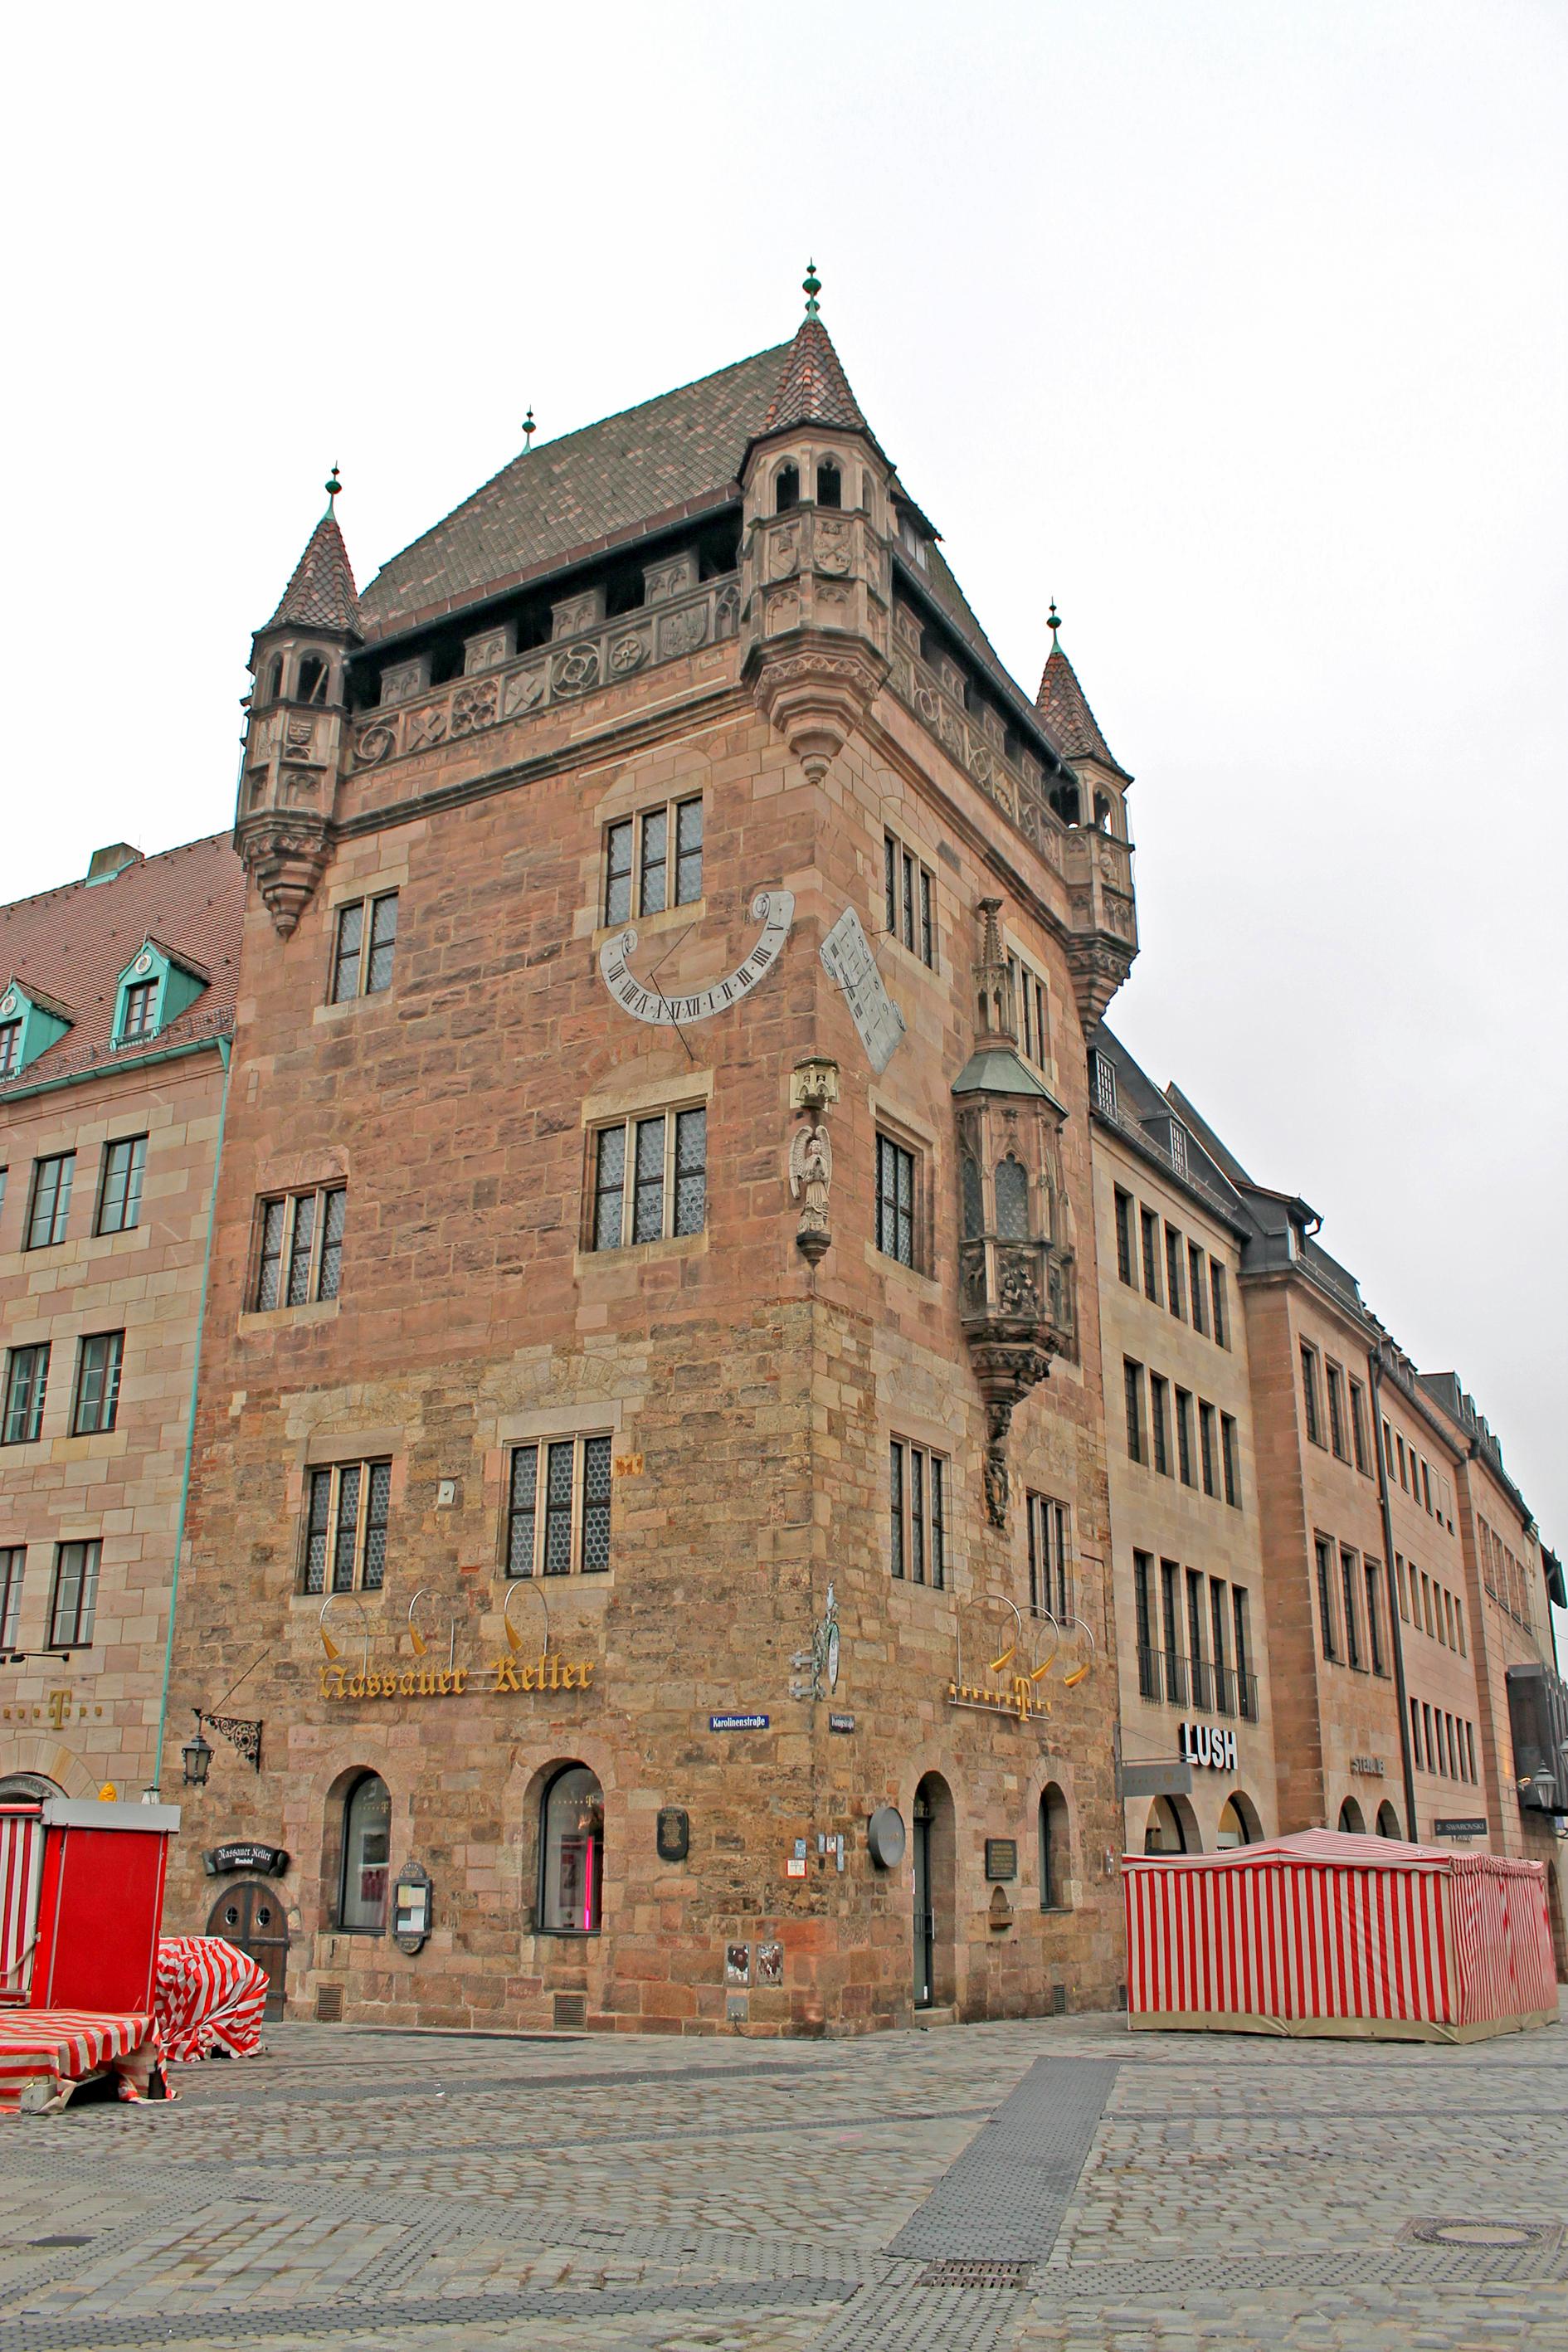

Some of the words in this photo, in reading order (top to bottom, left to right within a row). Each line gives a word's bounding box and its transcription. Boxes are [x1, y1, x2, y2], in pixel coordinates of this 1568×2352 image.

[607, 960, 626, 983] VII
[619, 979, 639, 1004] VIII
[635, 993, 653, 1015] IX
[652, 999, 663, 1019] X
[684, 997, 700, 1017] XII
[721, 982, 735, 1001] II
[736, 967, 754, 987] III
[751, 947, 772, 968] IIII
[767, 922, 785, 931] V
[319, 1663, 469, 1698] Nassauer
[490, 1652, 595, 1692] Keller
[713, 1716, 766, 1727] Karolinenstraße
[1183, 1722, 1239, 1770] LUSH
[218, 1848, 251, 1861] Nassauer
[251, 1848, 271, 1861] Keller
